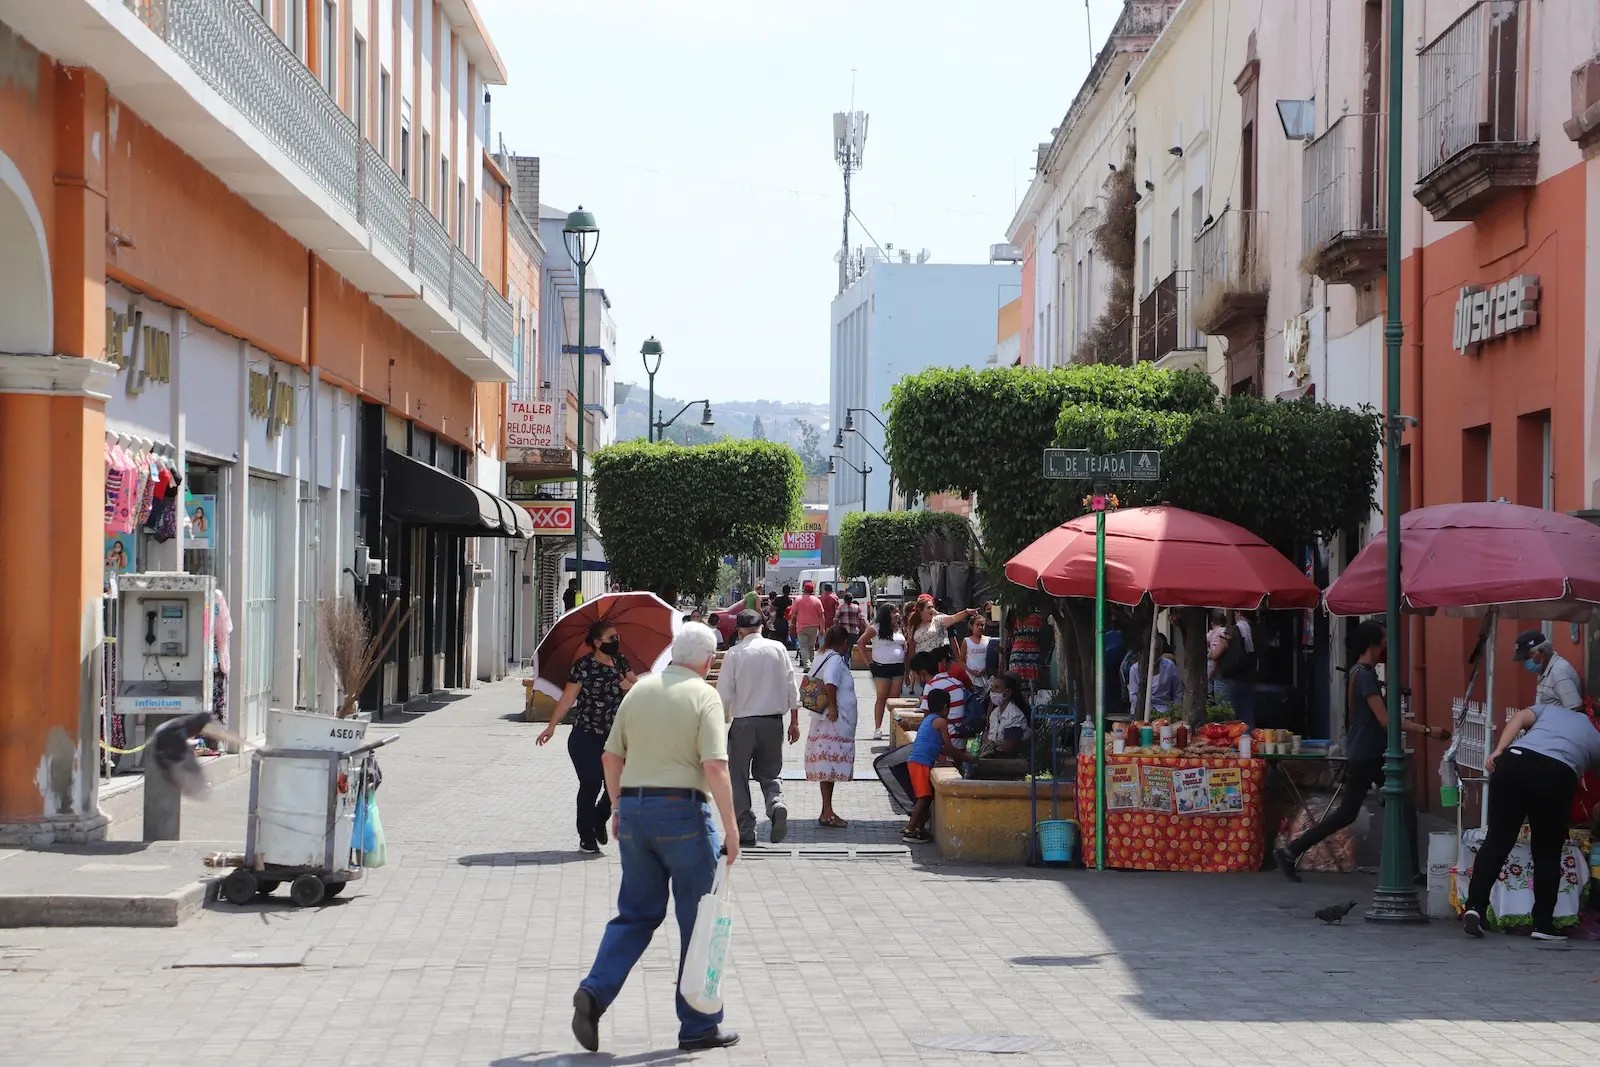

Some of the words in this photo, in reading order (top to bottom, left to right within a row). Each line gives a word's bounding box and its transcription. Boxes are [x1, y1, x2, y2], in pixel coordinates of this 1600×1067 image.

[511, 403, 551, 414] TALLER
[507, 423, 551, 434] RELOJERIA
[508, 433, 551, 446] Sanchez
[1049, 457, 1058, 472] L.
[1065, 457, 1077, 472] DE
[1085, 457, 1126, 472] TEJADA
[529, 507, 571, 527] XXO
[787, 532, 816, 543] MESES
[135, 699, 182, 707] infinitum
[330, 728, 353, 739] ASEO
